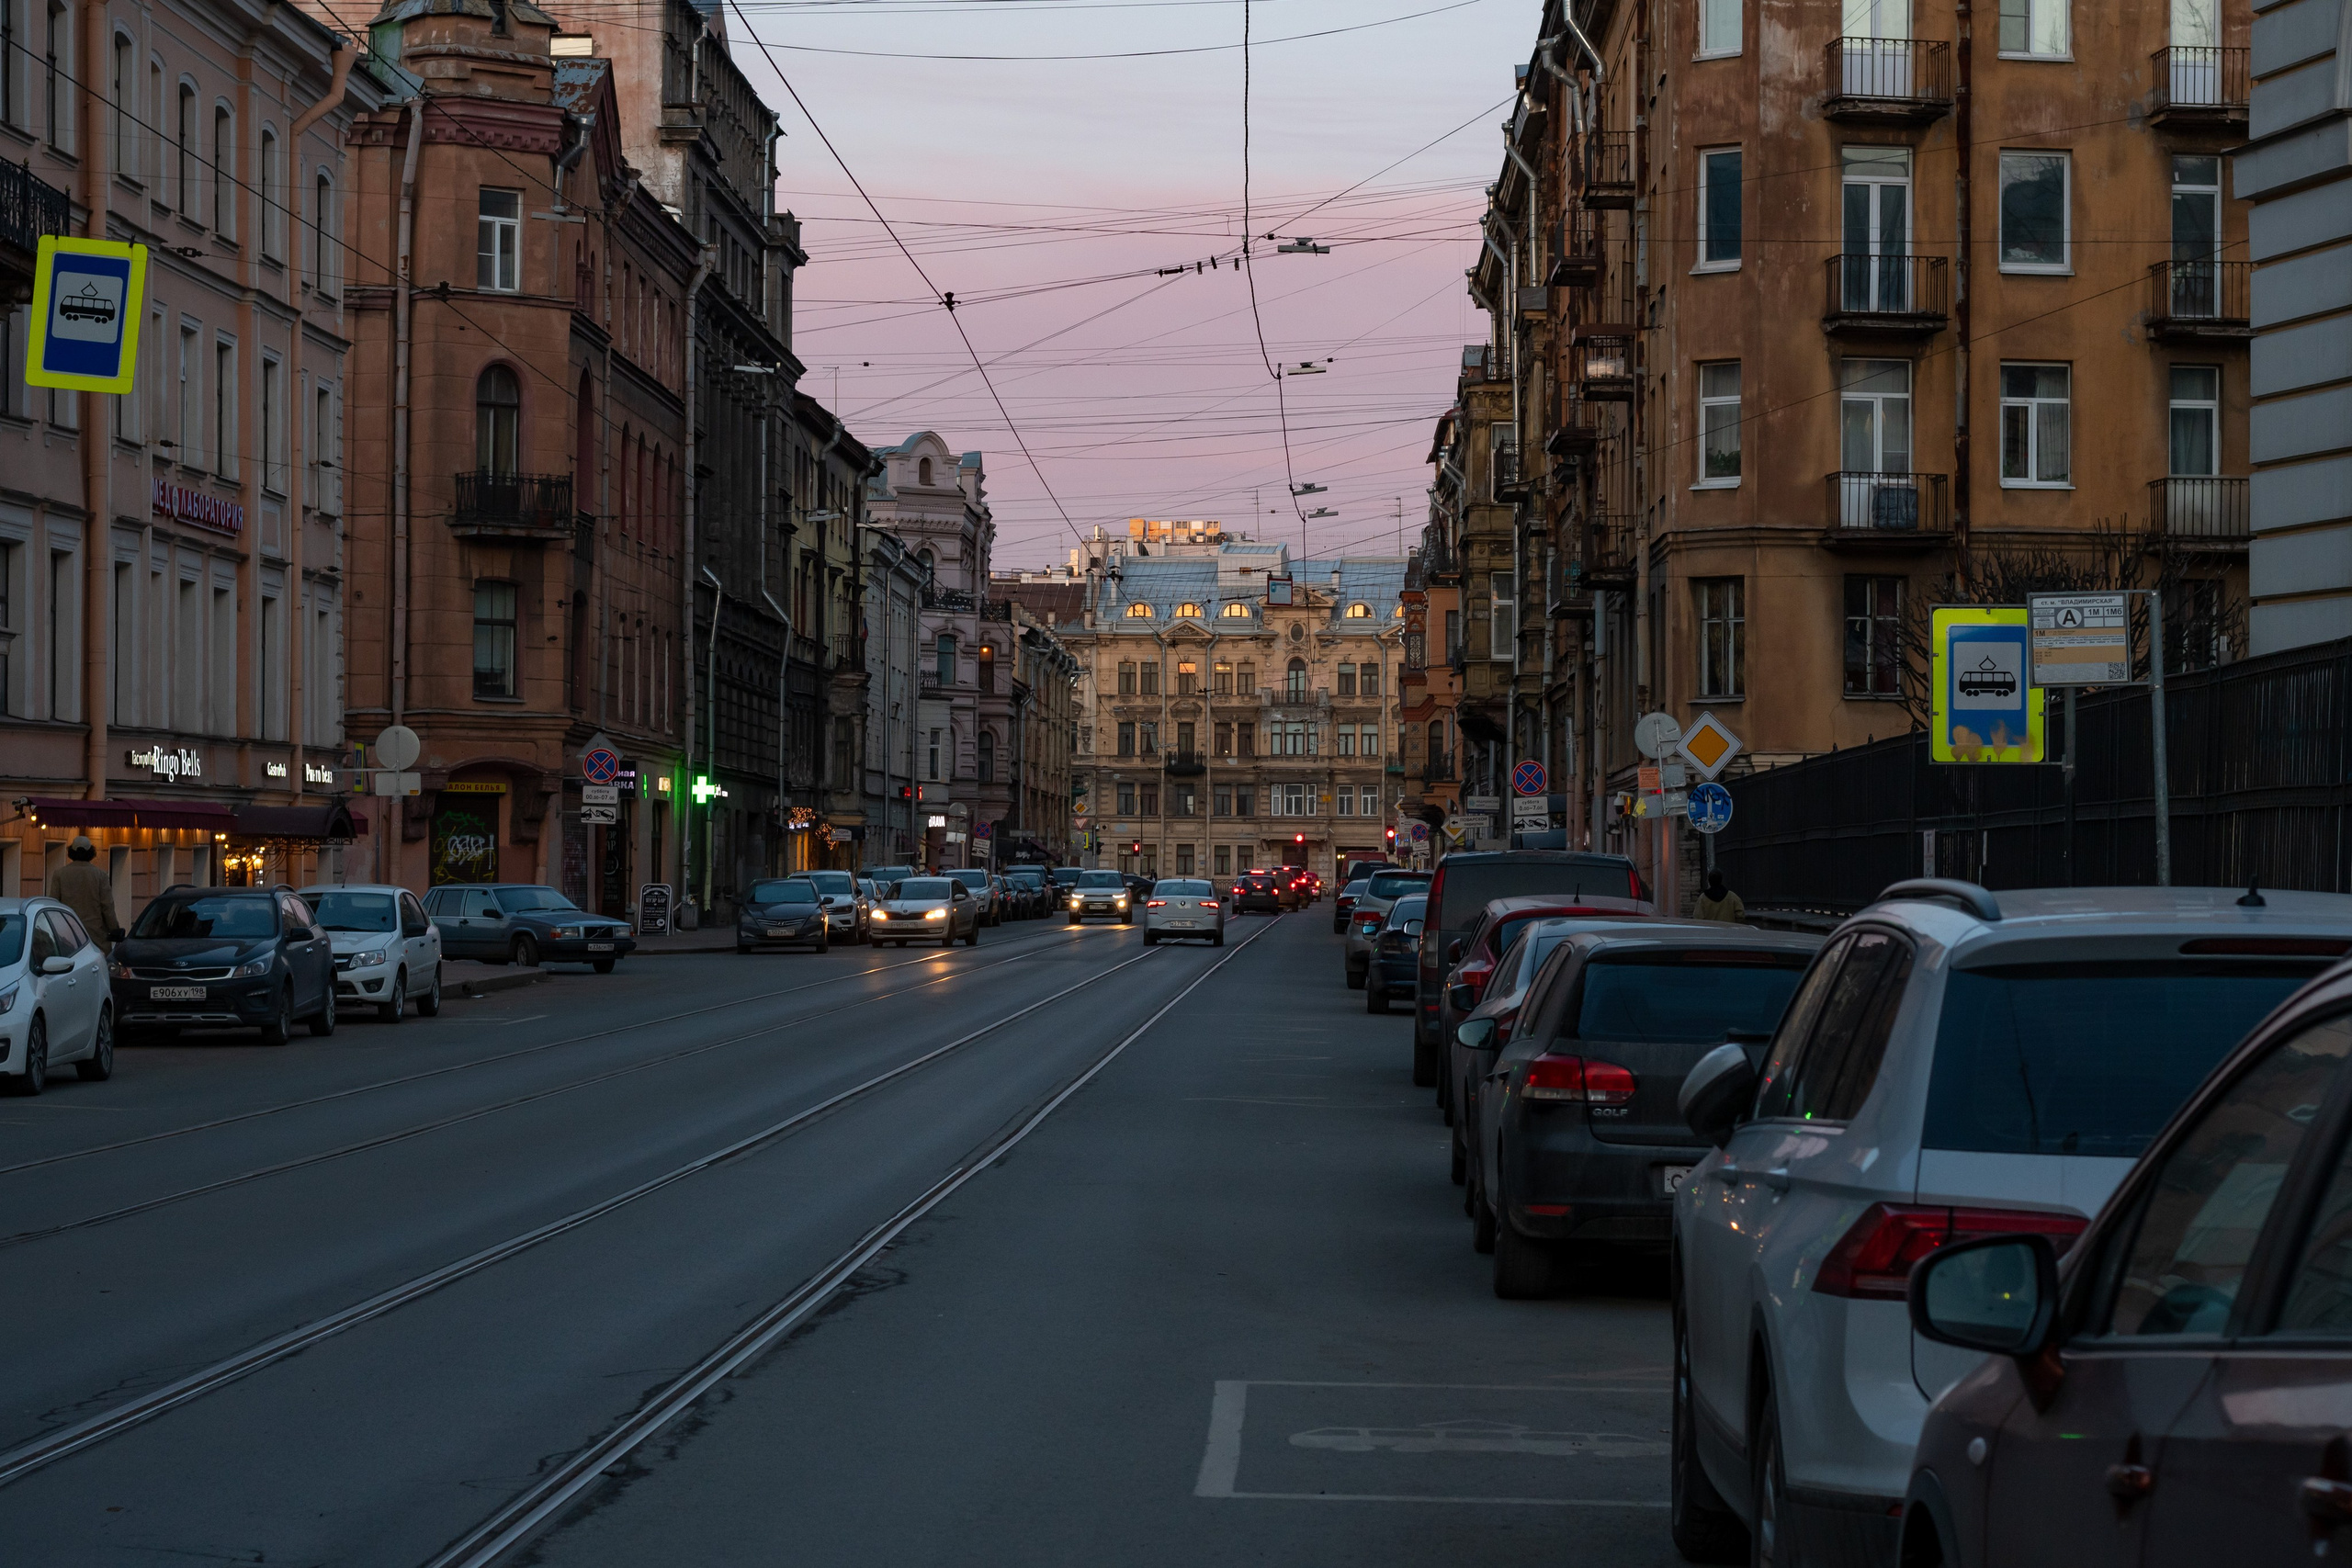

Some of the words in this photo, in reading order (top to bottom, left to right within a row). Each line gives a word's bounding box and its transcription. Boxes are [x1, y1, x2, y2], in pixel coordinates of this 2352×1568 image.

[152, 478, 172, 514] МЕД
[180, 489, 243, 531] ЛАБОРАТОРИЯ
[2063, 610, 2076, 625] А
[607, 781, 634, 789] АВКА
[1593, 1108, 1628, 1116] GOLF
